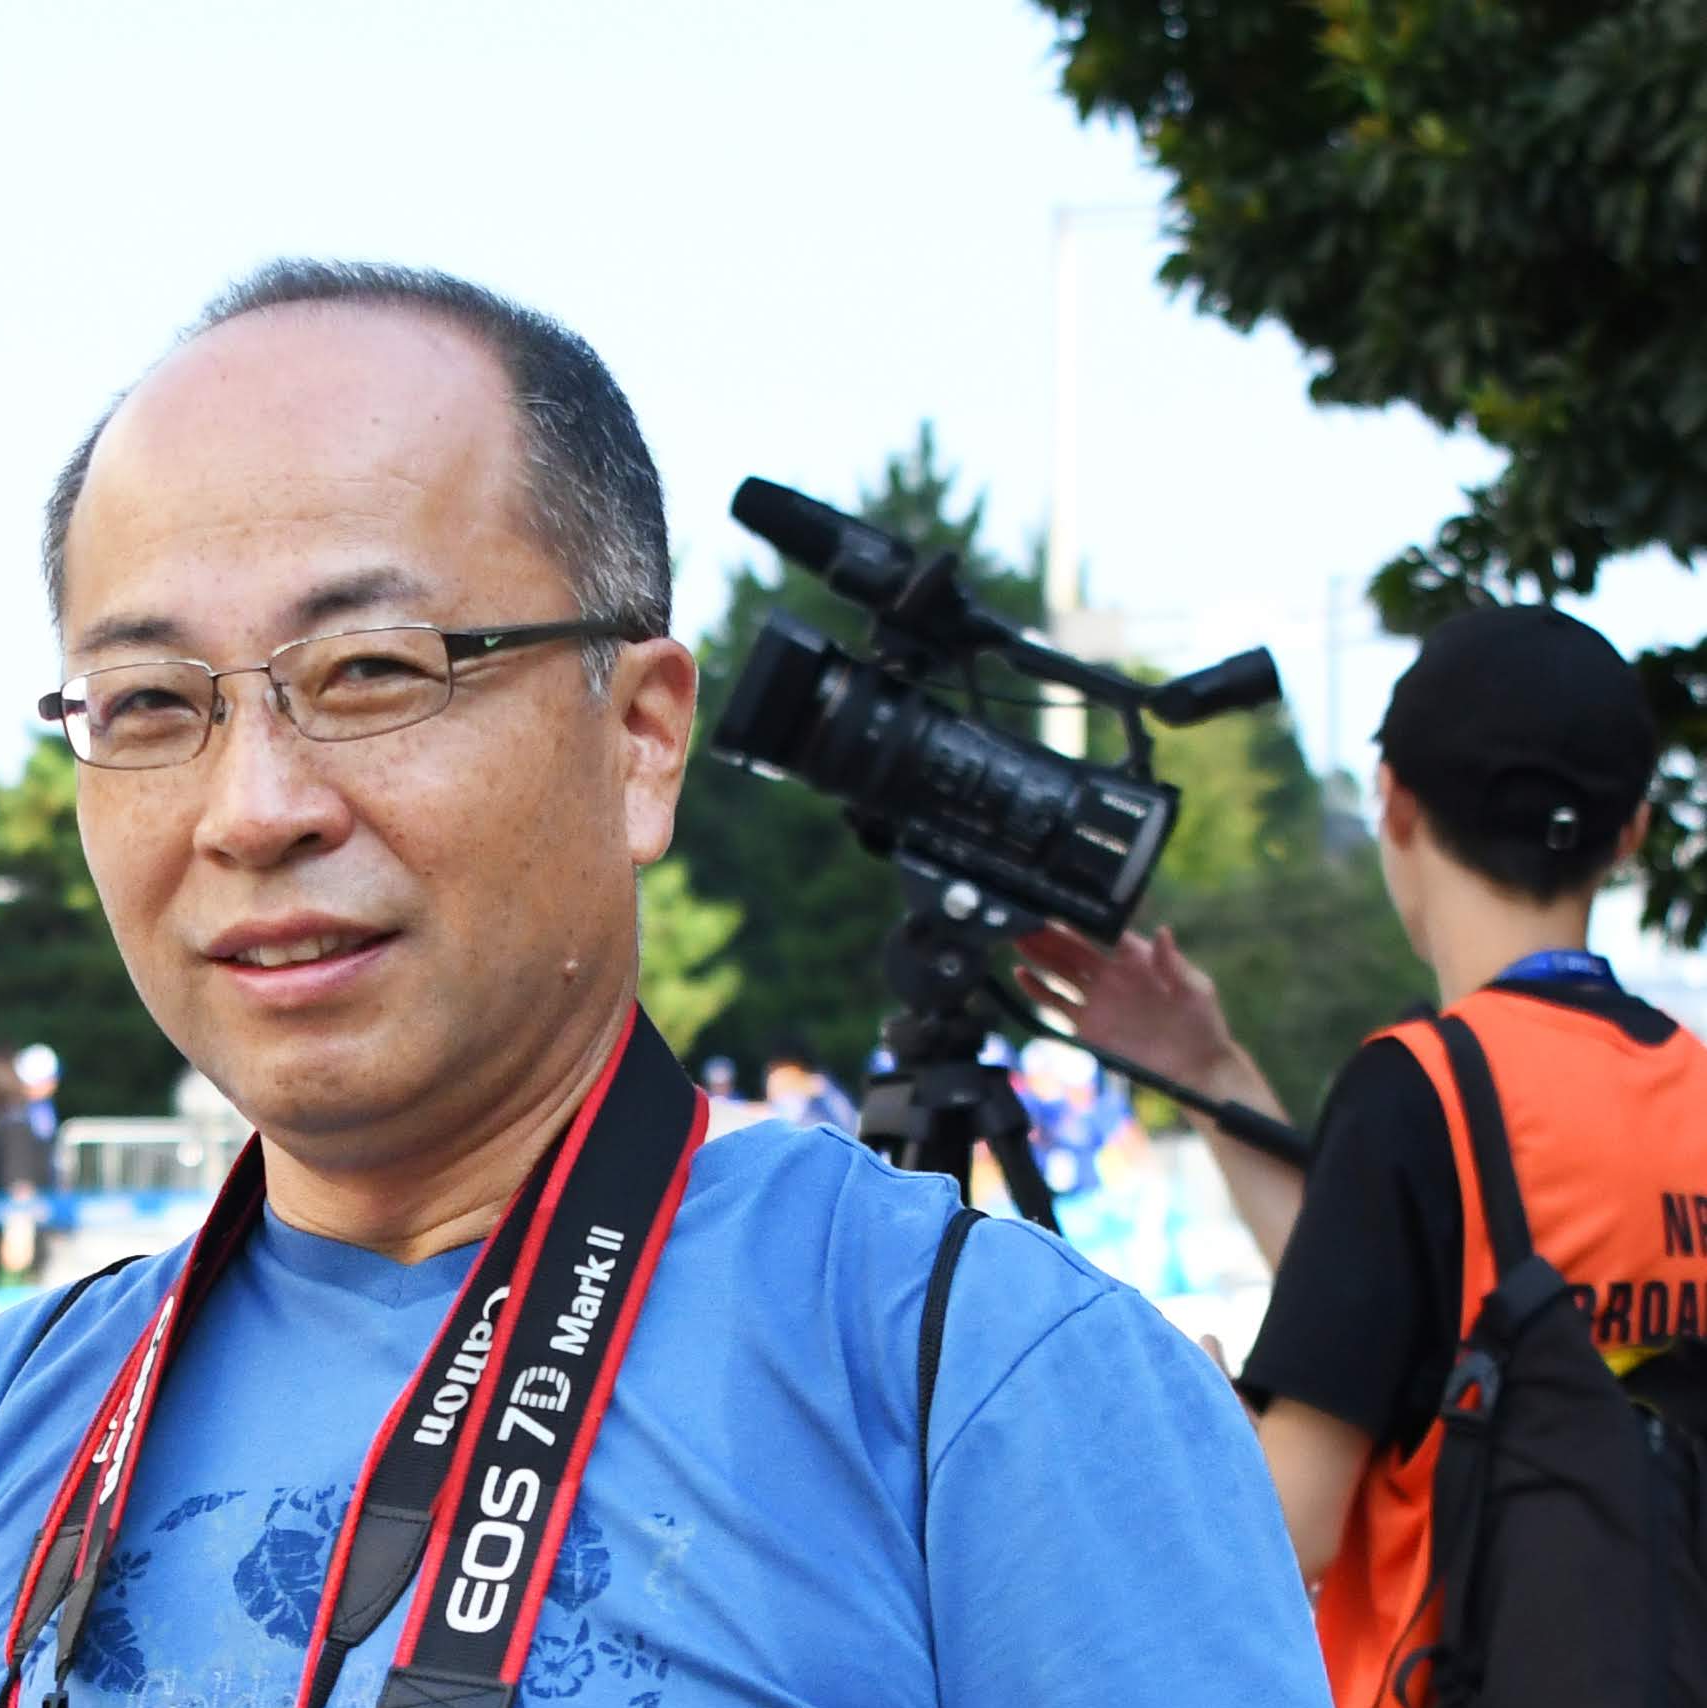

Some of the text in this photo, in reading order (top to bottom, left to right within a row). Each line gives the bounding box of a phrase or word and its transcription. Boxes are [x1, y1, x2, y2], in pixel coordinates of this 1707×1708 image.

[446, 1224, 625, 1634] EOS 7D Mark II
[1569, 1280, 1707, 1345] ROA
